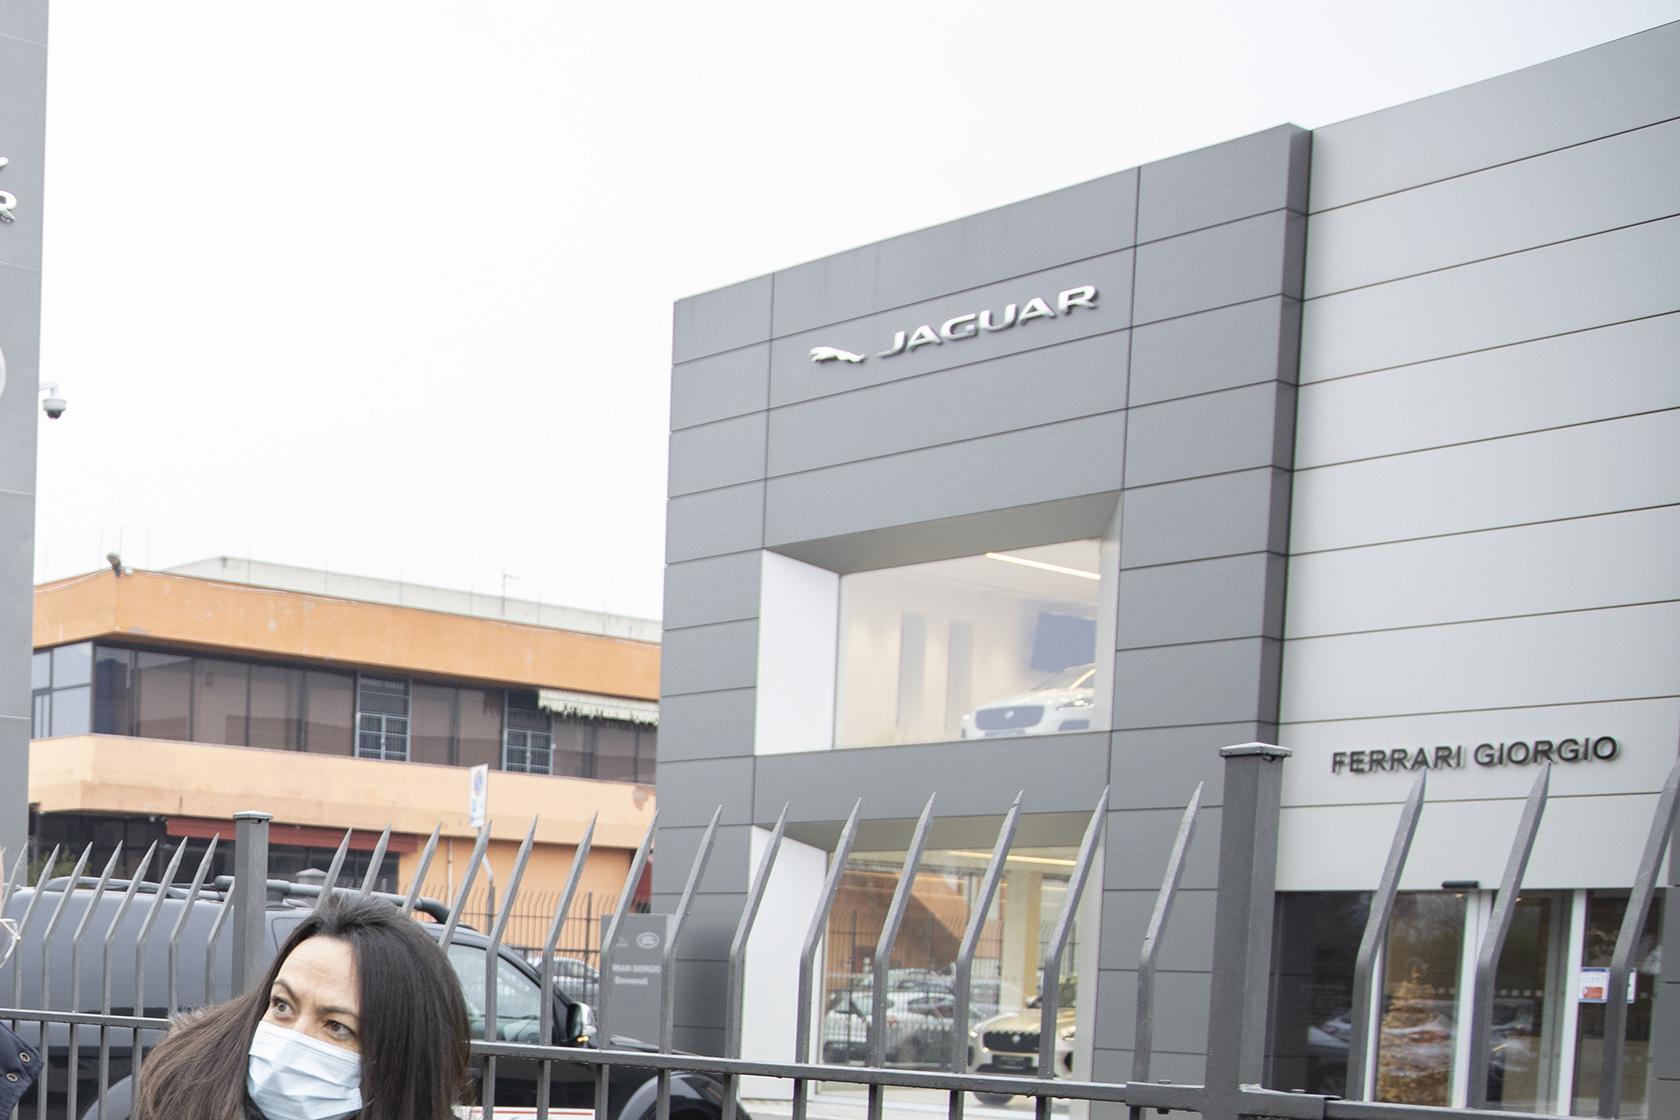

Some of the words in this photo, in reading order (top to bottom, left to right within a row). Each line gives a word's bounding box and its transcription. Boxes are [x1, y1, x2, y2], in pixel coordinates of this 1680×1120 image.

[876, 284, 1098, 358] JAGUAR
[1331, 745, 1462, 774] FERRARI
[1474, 735, 1618, 767] GIORGIO
